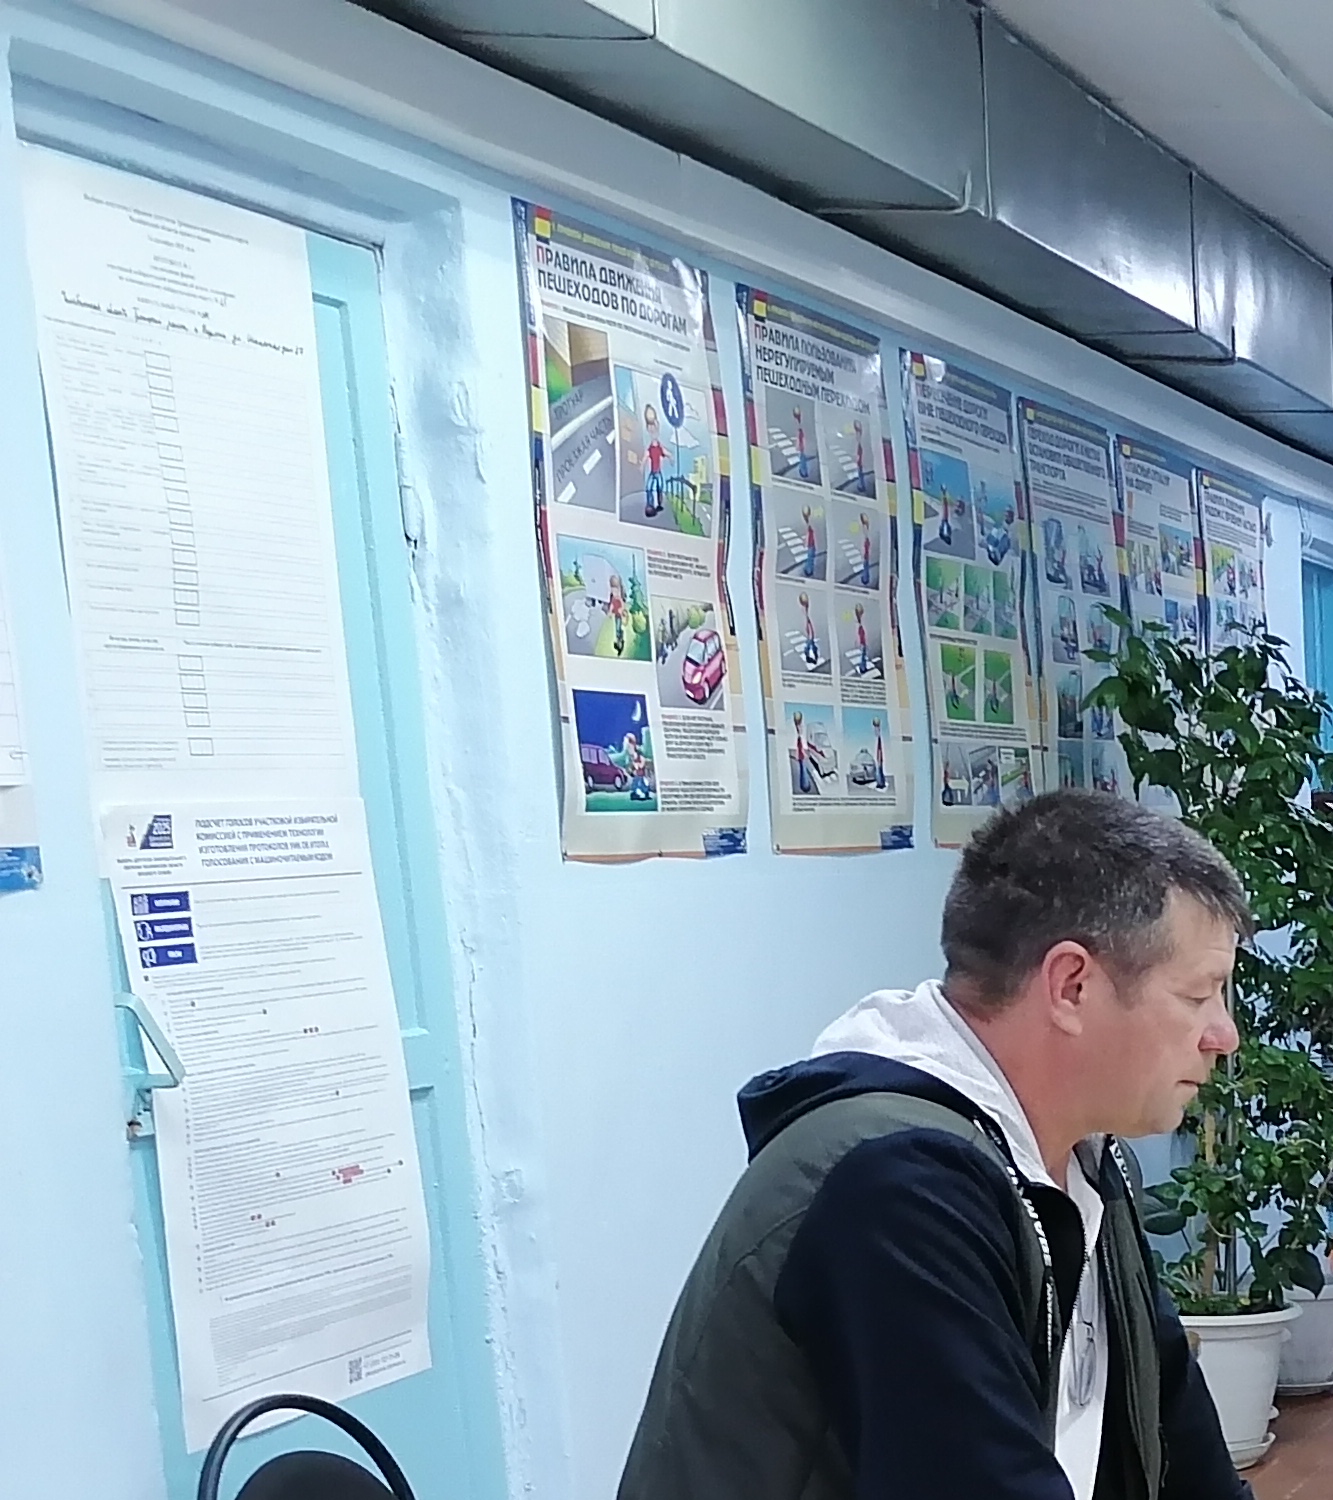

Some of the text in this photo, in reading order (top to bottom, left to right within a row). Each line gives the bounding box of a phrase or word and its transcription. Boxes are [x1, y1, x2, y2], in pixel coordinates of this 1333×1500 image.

[536, 245, 597, 281] ПРАВИЛА
[599, 267, 663, 303] ДВИЖЕНИЯ
[537, 270, 619, 310] ПЕШЕХОДОВ
[621, 296, 638, 316] ПО
[639, 304, 687, 335] ДОРОГАМ
[754, 324, 800, 352] ПРАВИЛА
[757, 365, 821, 399] ПЕШЕХОДНЫМ
